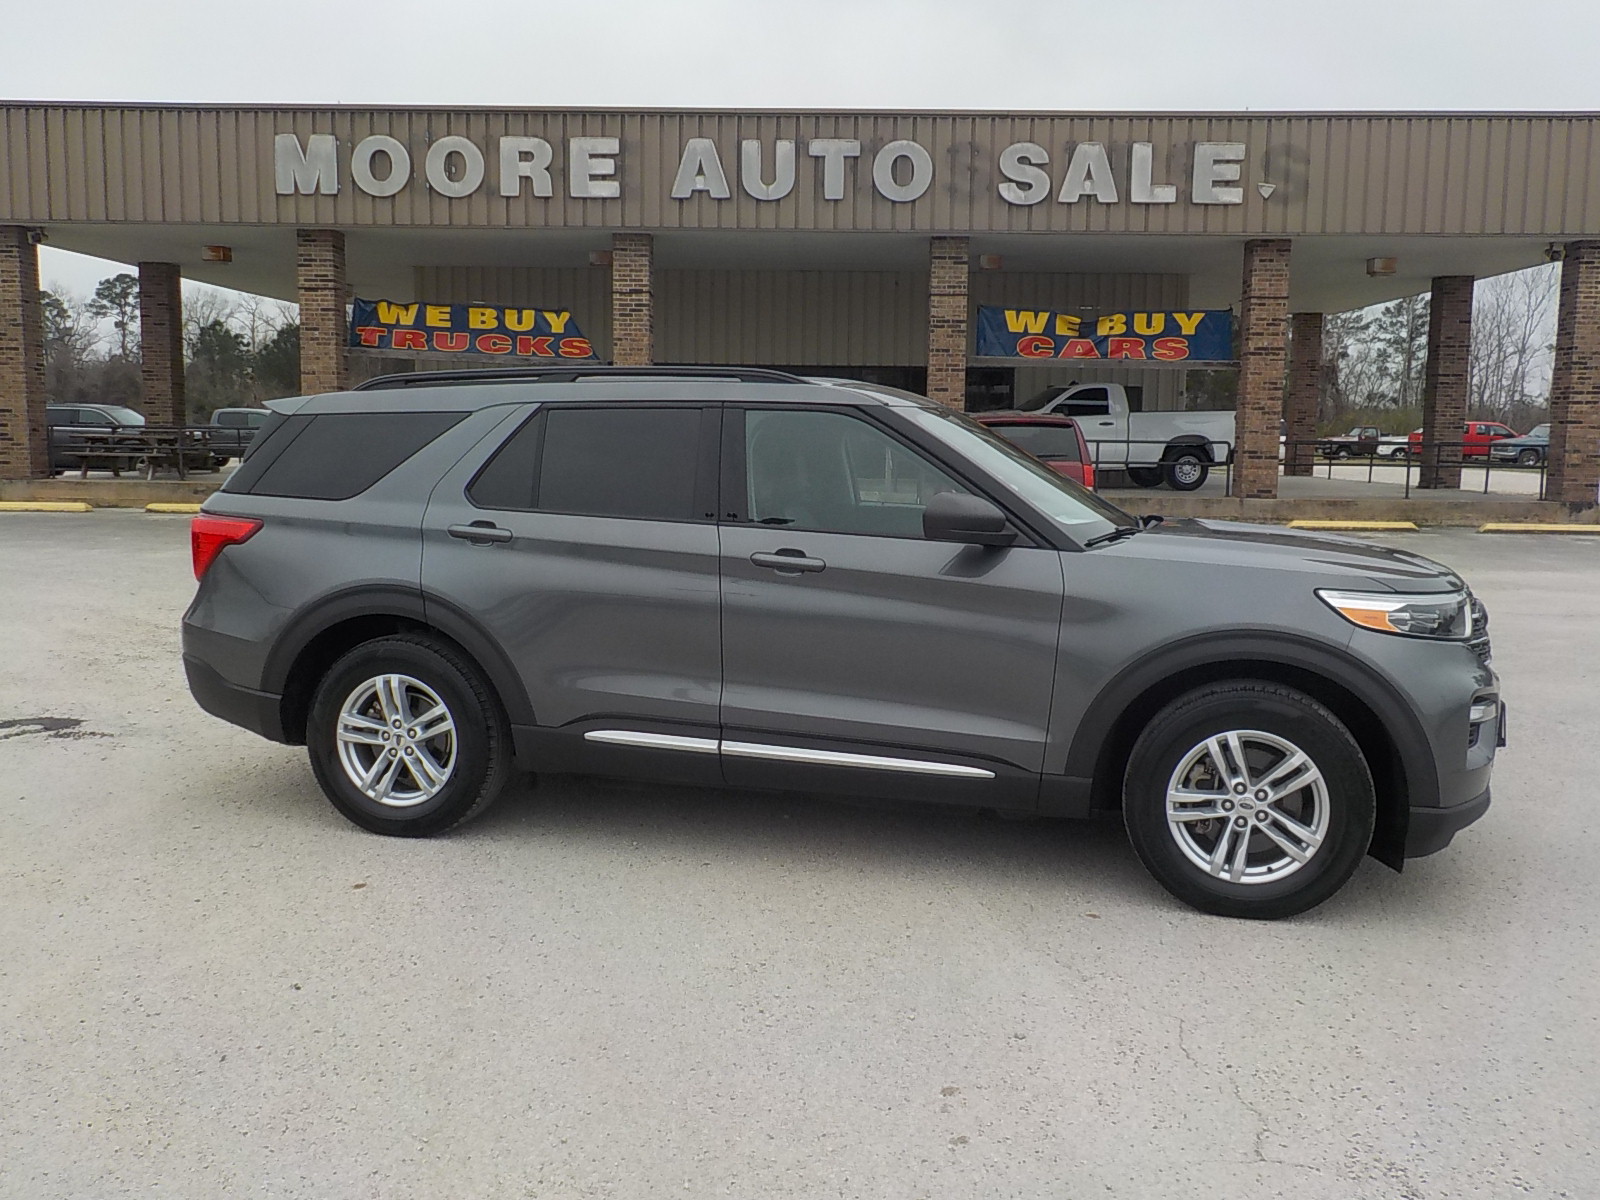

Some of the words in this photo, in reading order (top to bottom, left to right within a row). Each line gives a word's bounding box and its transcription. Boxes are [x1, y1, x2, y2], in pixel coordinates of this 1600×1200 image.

[274, 133, 621, 198] MOORE
[670, 137, 933, 202] AUTO
[998, 140, 1278, 206] SALE
[376, 301, 452, 328] WE
[468, 307, 571, 334] BUY
[1004, 309, 1082, 336] WE
[1096, 312, 1206, 336] BUY
[355, 326, 594, 358] TRUCKS
[1016, 335, 1190, 361] CARS
